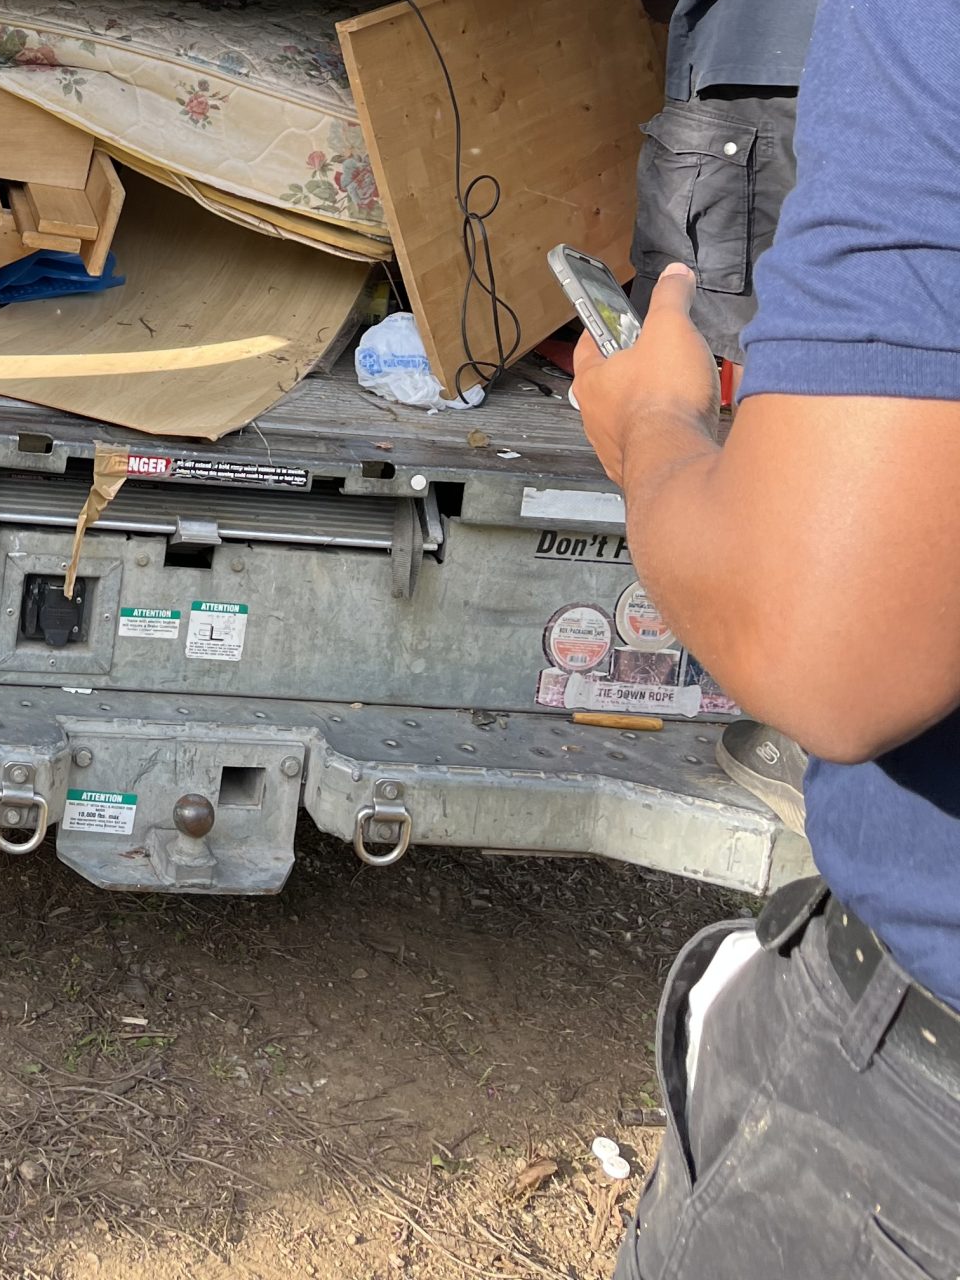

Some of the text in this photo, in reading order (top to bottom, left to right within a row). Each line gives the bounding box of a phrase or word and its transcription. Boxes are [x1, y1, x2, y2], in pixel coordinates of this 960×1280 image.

[128, 456, 167, 473] NGER
[536, 529, 608, 558] Don't
[132, 608, 171, 618] ATTENTION
[200, 602, 240, 612] ATTENTION
[598, 688, 674, 702] TIE-DOWN ROPE
[81, 791, 123, 803] ATTENTION
